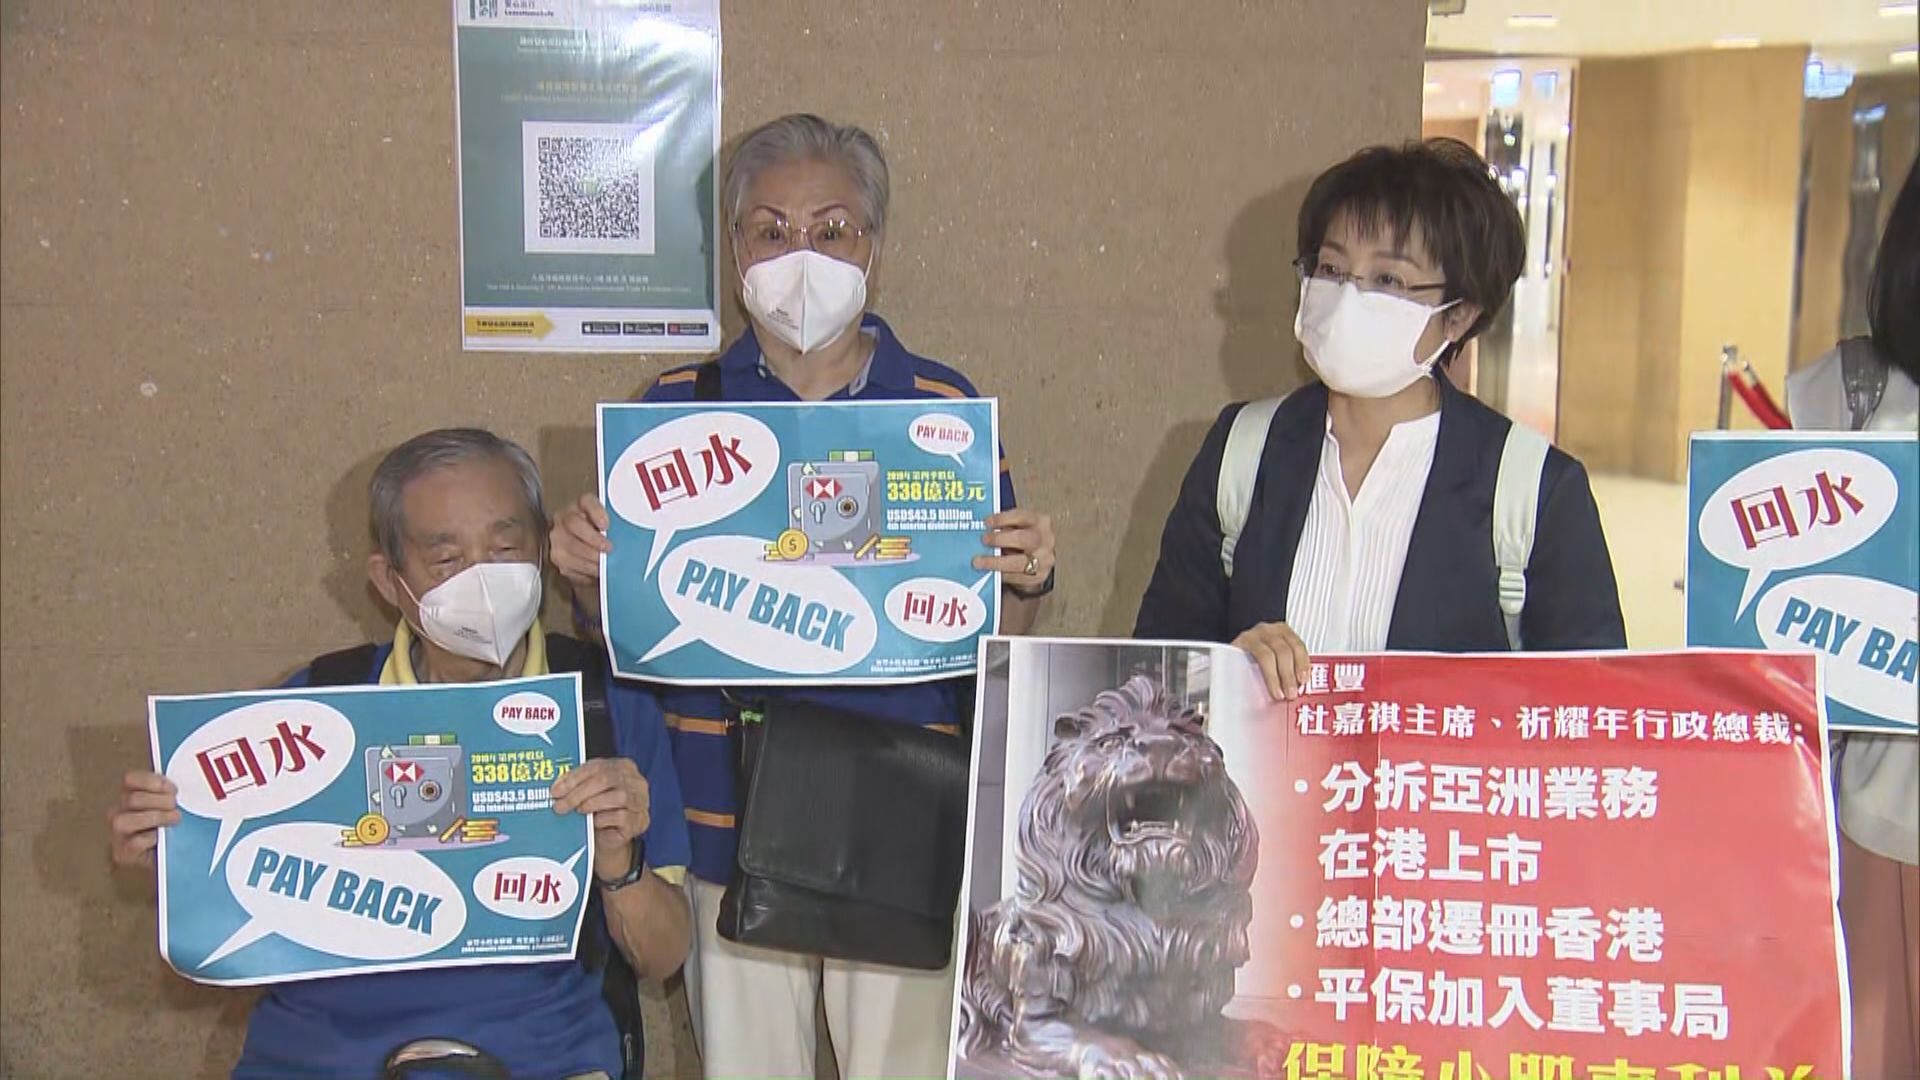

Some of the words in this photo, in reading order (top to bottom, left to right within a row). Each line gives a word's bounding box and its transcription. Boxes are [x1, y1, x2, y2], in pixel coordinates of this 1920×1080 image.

[916, 424, 937, 438] PAY
[939, 427, 969, 442] BACK
[634, 432, 753, 512] 回水
[887, 480, 986, 502] 338億港元
[1730, 470, 1865, 550] 回水
[676, 558, 751, 612] PAY
[748, 583, 855, 653] BACK
[903, 591, 968, 626] 回水
[1776, 596, 1860, 656] PAY
[501, 706, 522, 719] PAY
[525, 706, 555, 720] BACK
[196, 720, 327, 801] 回水
[1321, 759, 1659, 821] 分拆亞洲業務
[1317, 827, 1543, 886] 在港上市
[247, 846, 330, 902] PAY
[327, 873, 443, 935] BACK
[494, 872, 562, 904] 回水
[1315, 895, 1665, 964] 總部遷冊香港
[1315, 966, 1730, 1041] 平保加入董事局
